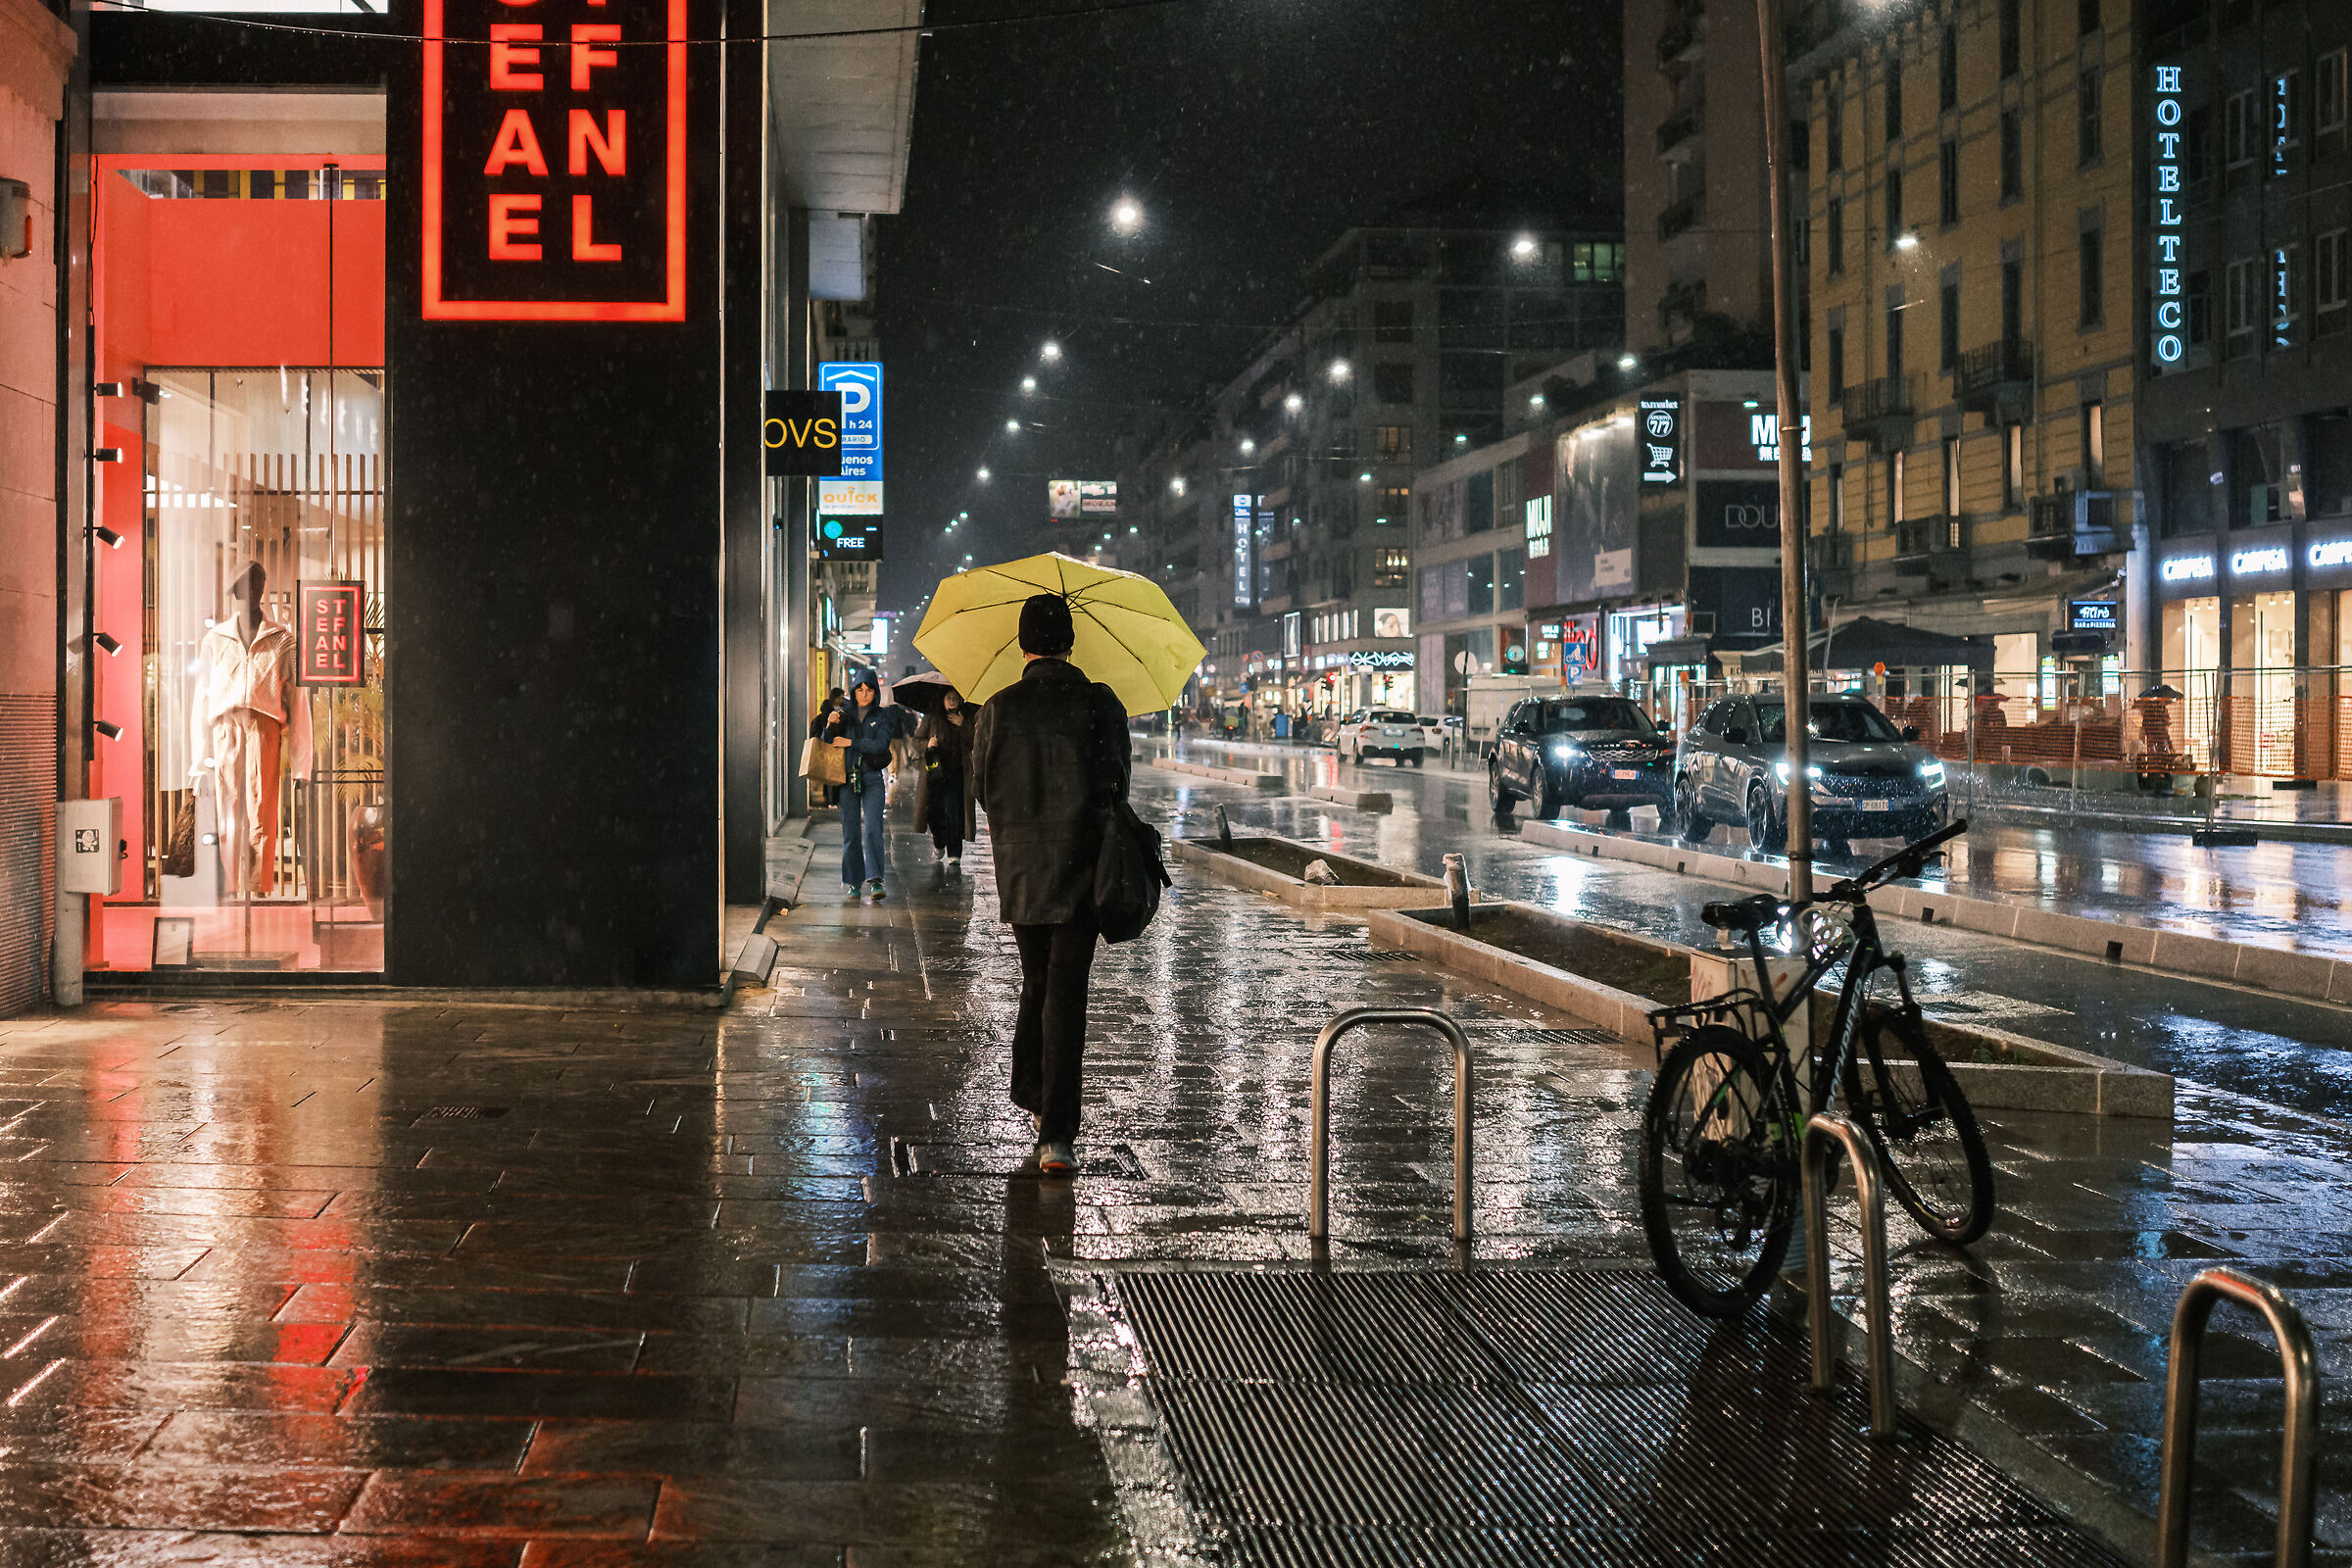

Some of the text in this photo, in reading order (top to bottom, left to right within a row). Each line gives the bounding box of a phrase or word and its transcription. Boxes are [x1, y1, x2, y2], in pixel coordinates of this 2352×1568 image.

[2156, 66, 2182, 362] HOTEL TECO
[835, 382, 871, 429] P
[764, 417, 838, 449] OVS
[1649, 419, 1670, 434] 7/7
[823, 485, 879, 504] QUICK
[1526, 494, 1553, 540] MUJI
[836, 537, 866, 549] FREE
[1237, 523, 1249, 592] HOTEL
